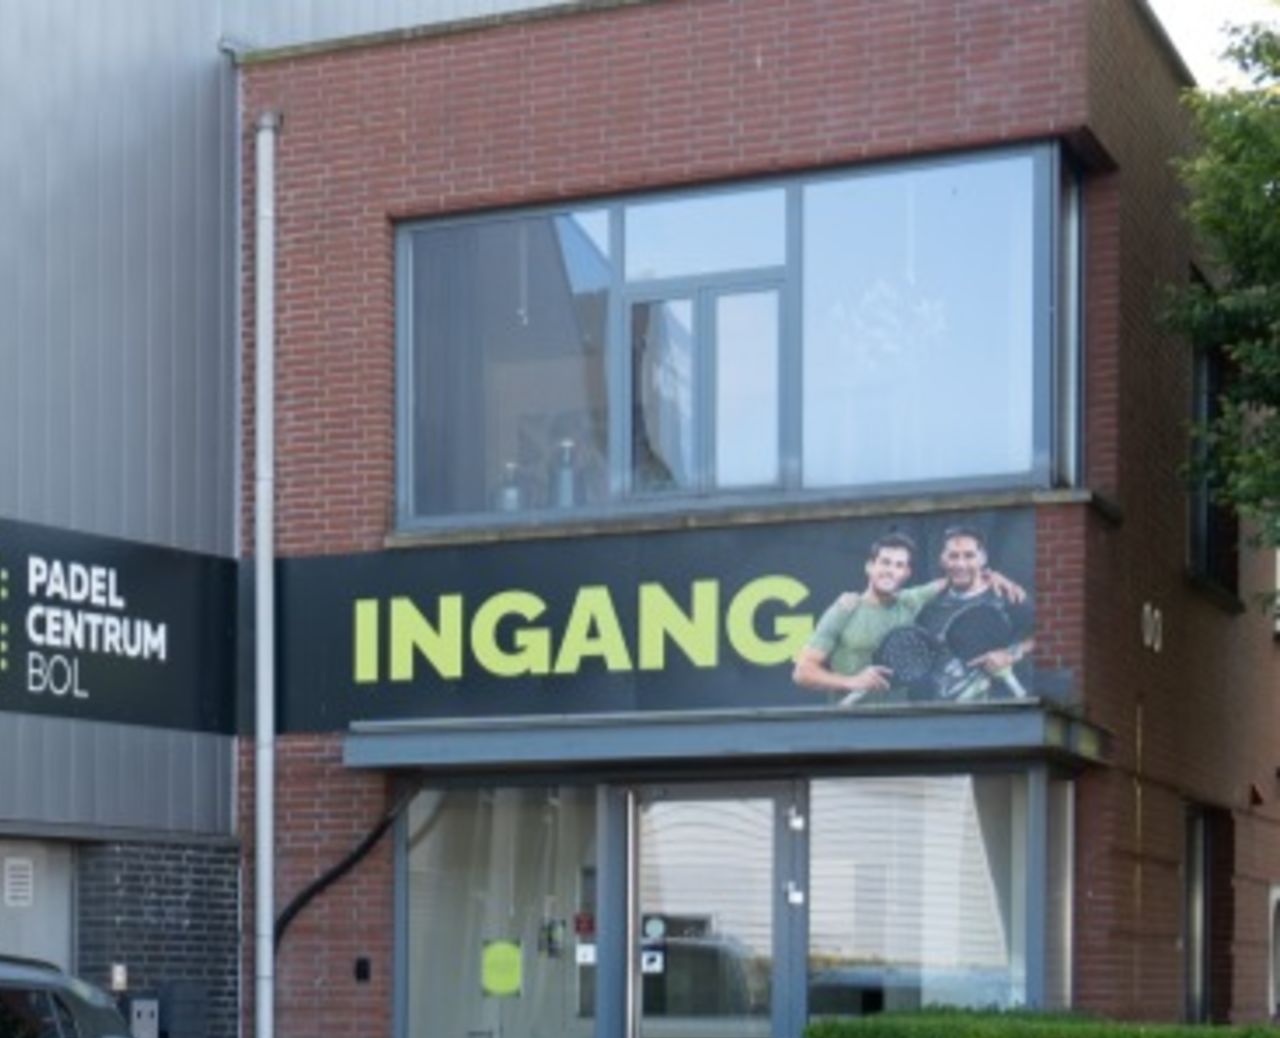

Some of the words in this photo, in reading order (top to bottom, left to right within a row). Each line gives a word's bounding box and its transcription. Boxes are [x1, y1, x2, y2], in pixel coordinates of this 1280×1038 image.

[27, 554, 126, 608] PADEL
[26, 604, 167, 661] CENTRUM
[353, 574, 815, 684] INGANG
[27, 651, 89, 698] BOL
